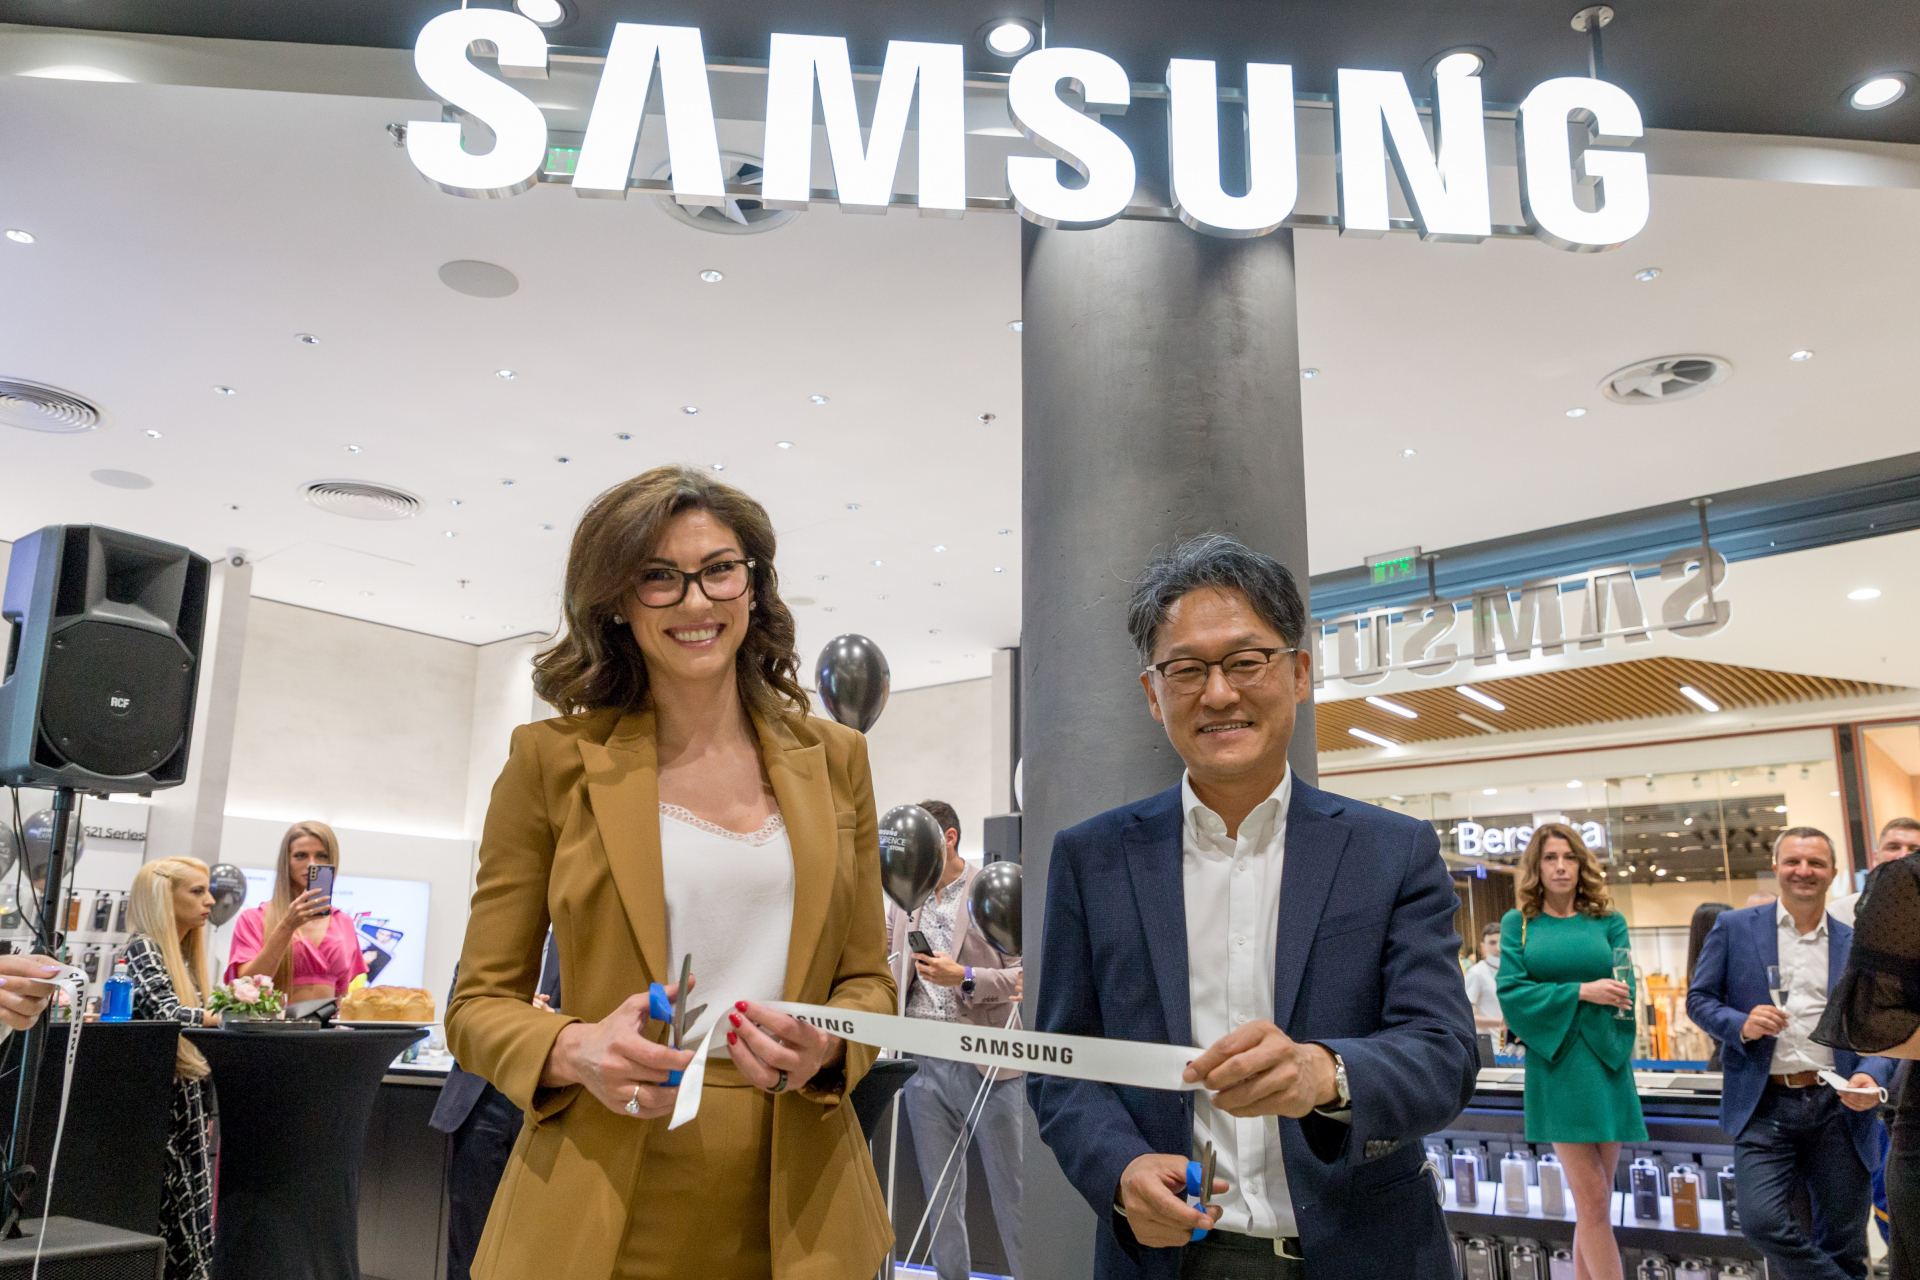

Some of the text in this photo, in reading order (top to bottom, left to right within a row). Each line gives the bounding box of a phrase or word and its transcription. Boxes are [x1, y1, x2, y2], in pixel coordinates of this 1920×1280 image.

[406, 8, 1651, 251] SAMSUNG
[110, 696, 130, 708] RCF
[84, 825, 147, 841] S21 Series
[1457, 815, 1605, 855] Bersa
[786, 1013, 855, 1035] SUNG
[960, 1035, 1073, 1064] SAMSUNG
